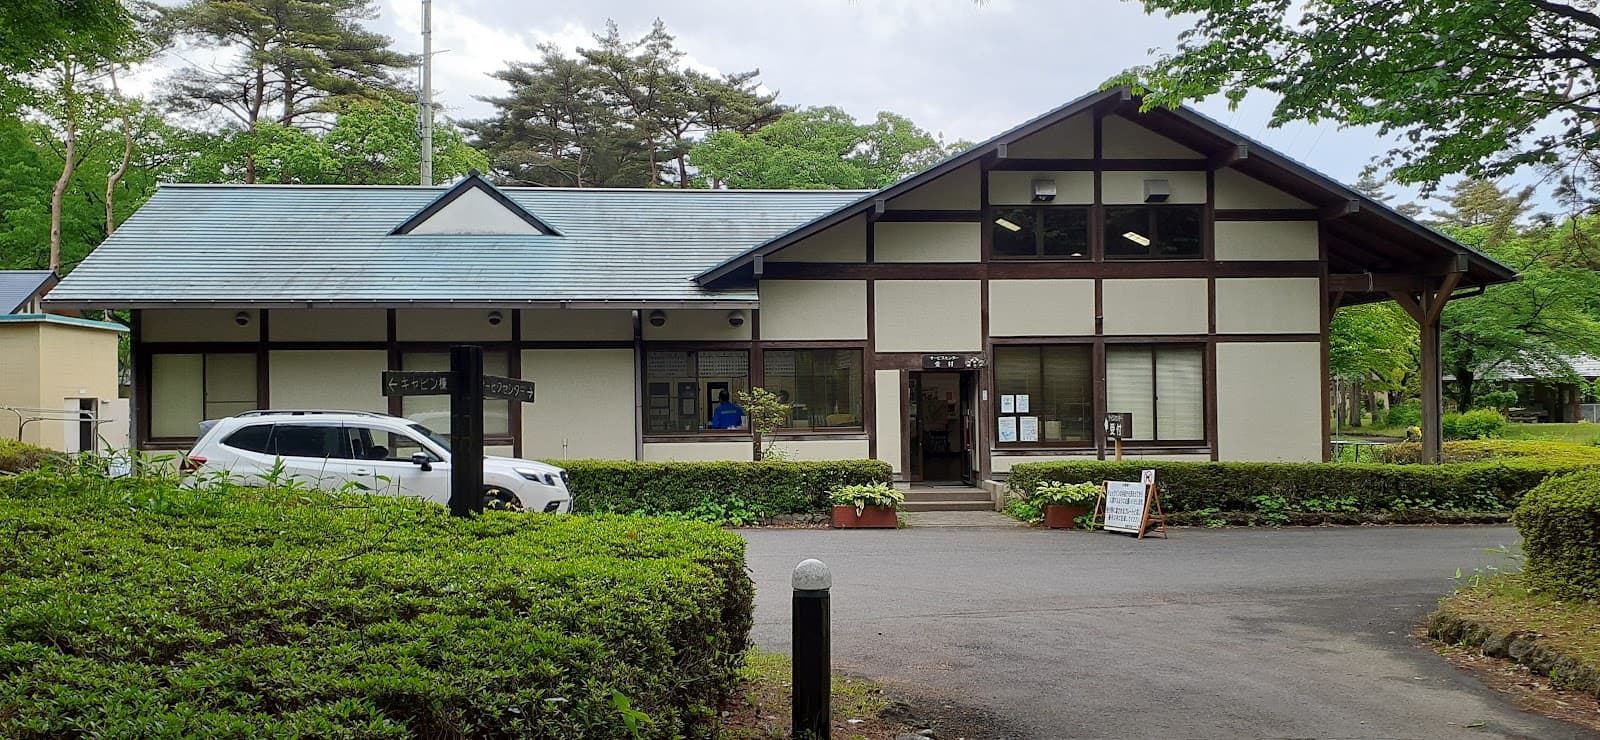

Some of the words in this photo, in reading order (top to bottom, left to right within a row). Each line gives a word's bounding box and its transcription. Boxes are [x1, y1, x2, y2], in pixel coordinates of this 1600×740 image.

[401, 376, 448, 393] キャビン棟
[484, 382, 525, 397] ービスセンター
